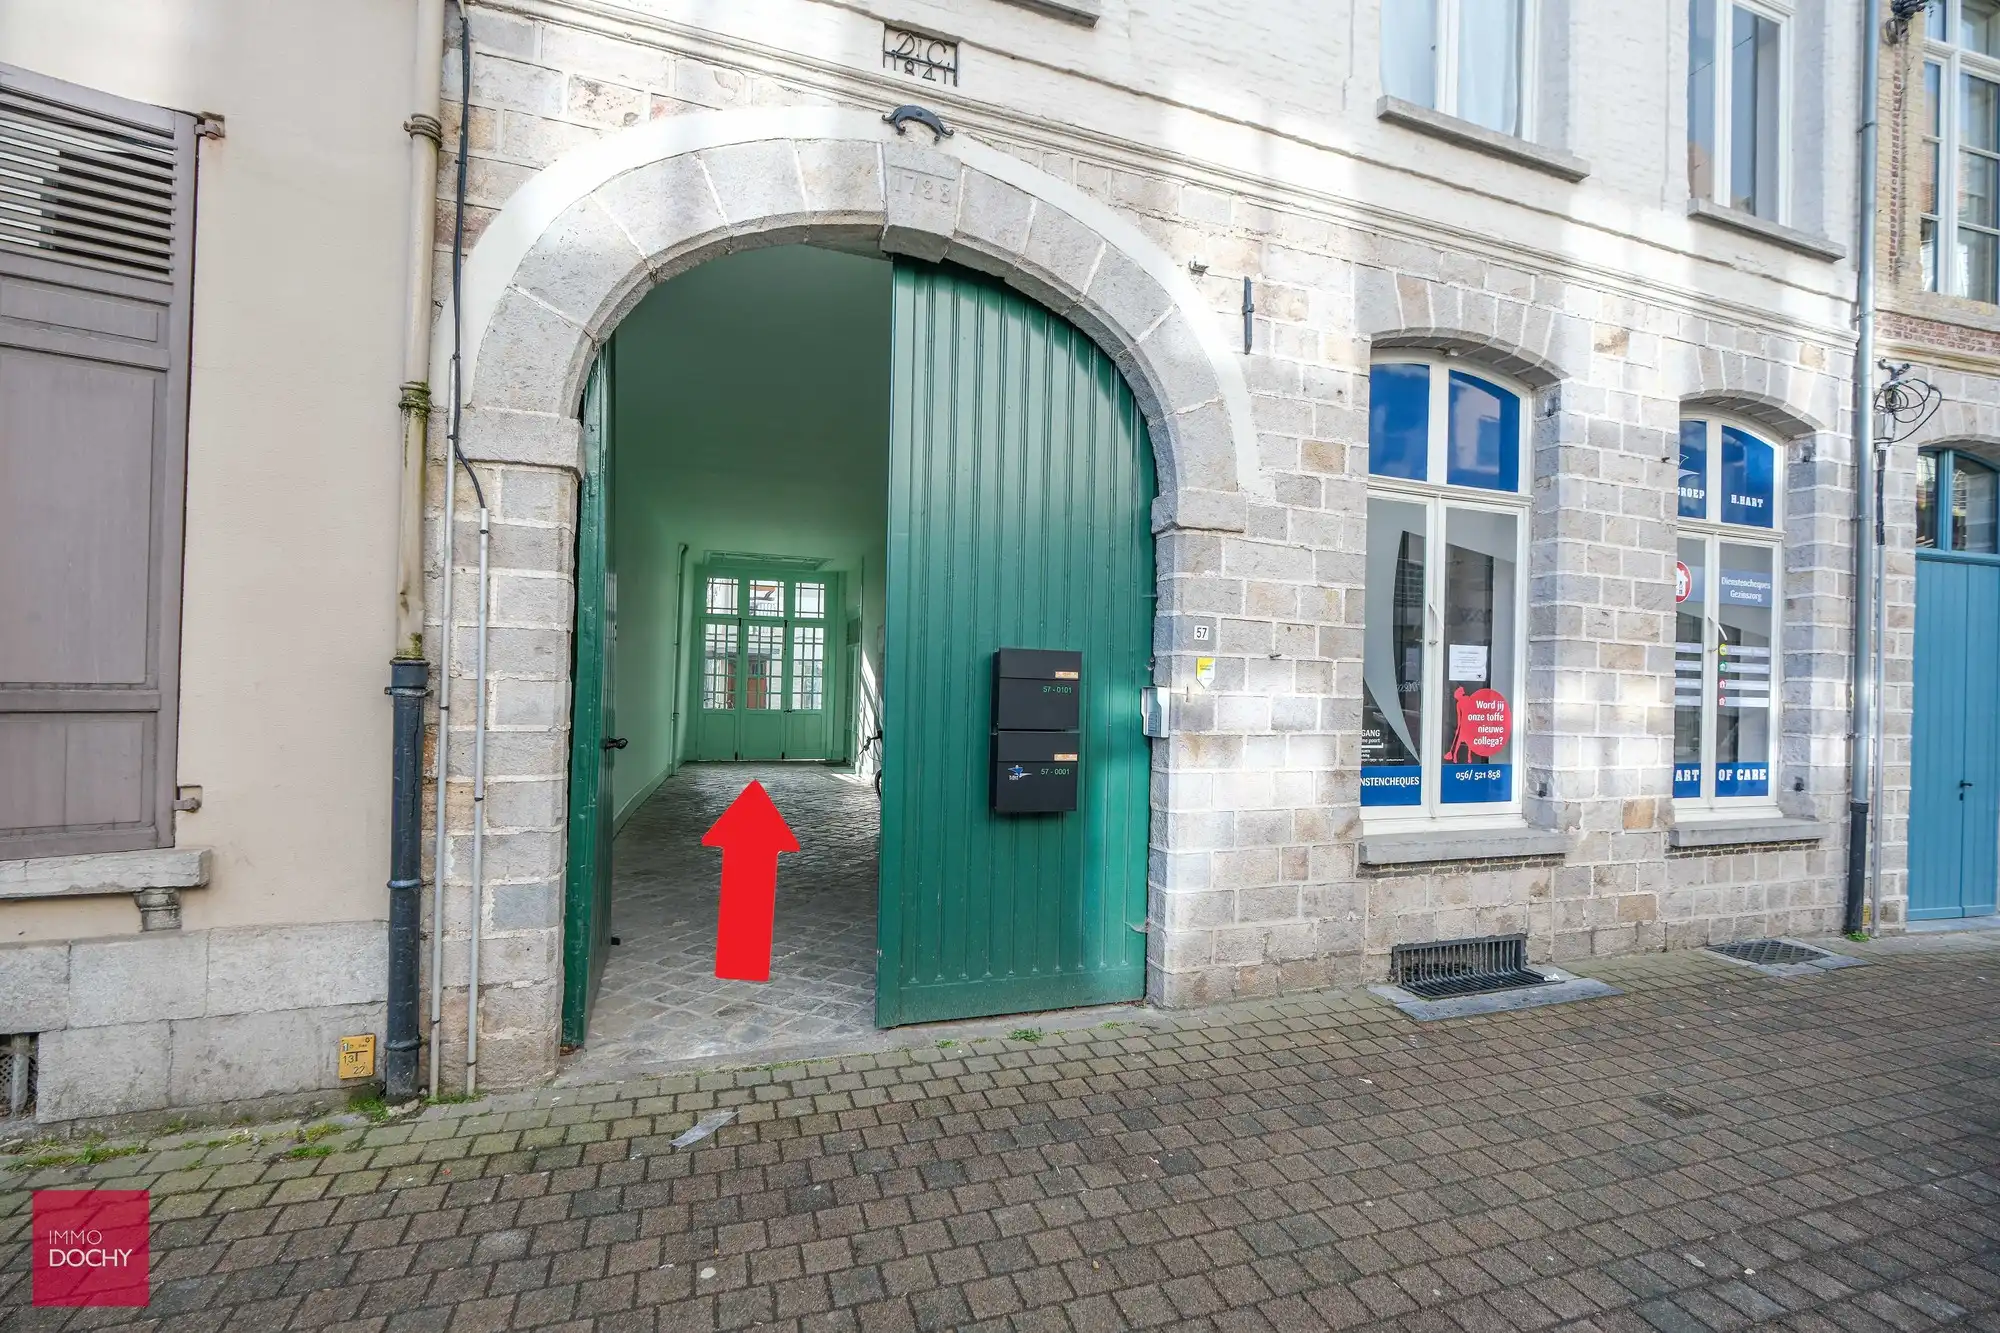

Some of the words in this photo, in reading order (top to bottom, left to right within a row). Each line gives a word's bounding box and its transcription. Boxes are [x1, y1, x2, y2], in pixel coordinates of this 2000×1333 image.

[1731, 494, 1764, 508] H.HART
[1721, 576, 1771, 590] Dienstencheques
[1730, 589, 1763, 602] Gezinszorg
[1196, 627, 1207, 638] 57
[1056, 686, 1072, 694] 0101
[1476, 700, 1496, 709] Word
[1497, 700, 1505, 712] jij
[1467, 713, 1485, 721] onze
[1486, 711, 1504, 721] toffe
[1477, 724, 1504, 733] nieuwe
[1473, 736, 1503, 748] collega?
[1455, 770, 1473, 780] 056/
[1474, 772, 1486, 780] 521
[1487, 769, 1501, 780] 858
[1718, 768, 1732, 781] OF
[1736, 768, 1766, 780] CARE
[343, 1054, 355, 1064] 13
